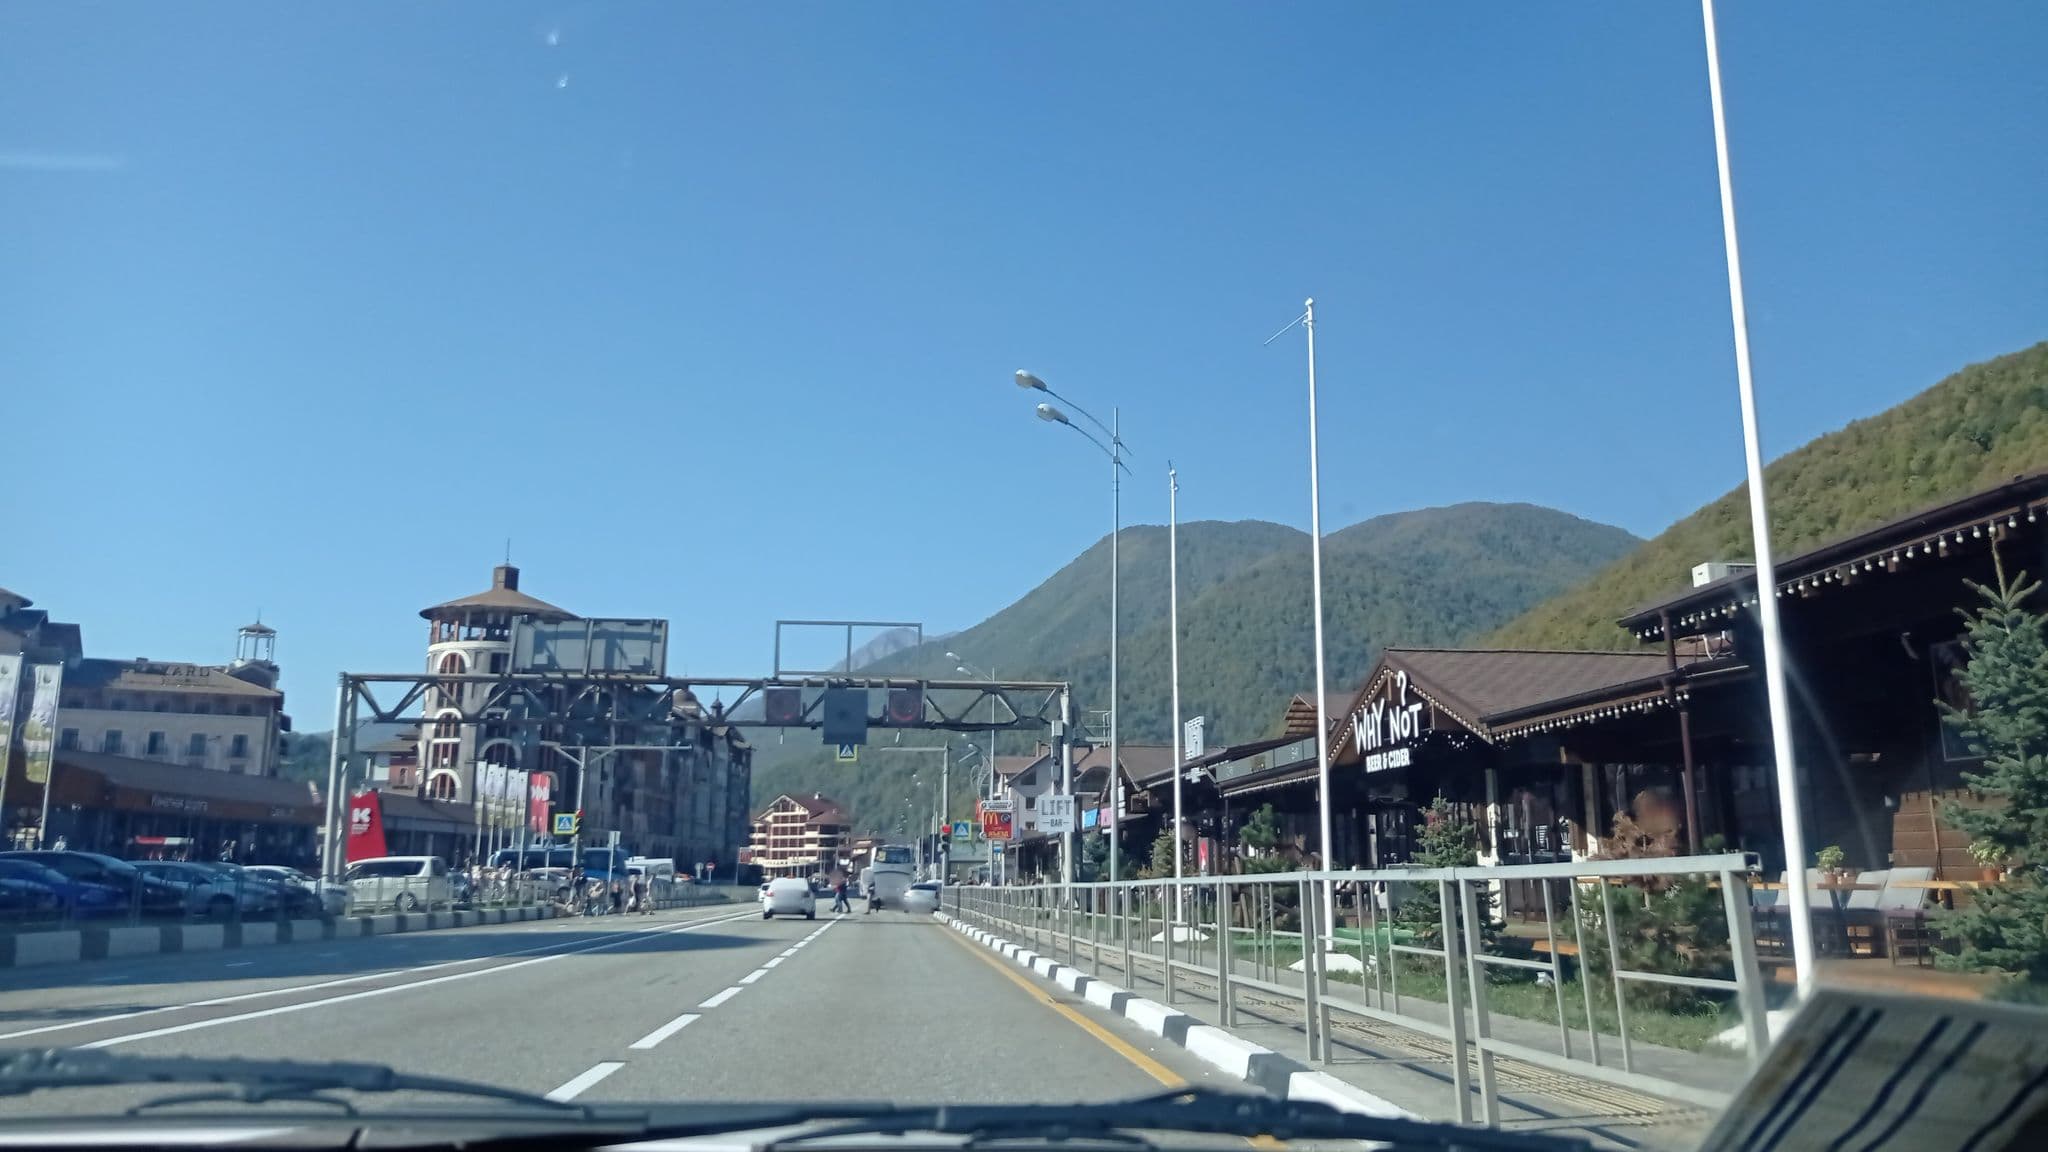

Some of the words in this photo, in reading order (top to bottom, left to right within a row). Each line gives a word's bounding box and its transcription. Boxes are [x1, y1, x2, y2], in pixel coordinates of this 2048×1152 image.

[1353, 698, 1385, 755] WHY
[1389, 703, 1422, 745] NOT
[1366, 753, 1382, 773] BEER
[1388, 748, 1411, 768] CIDER
[1041, 799, 1072, 816] LIFT
[1050, 818, 1063, 827] BAR
